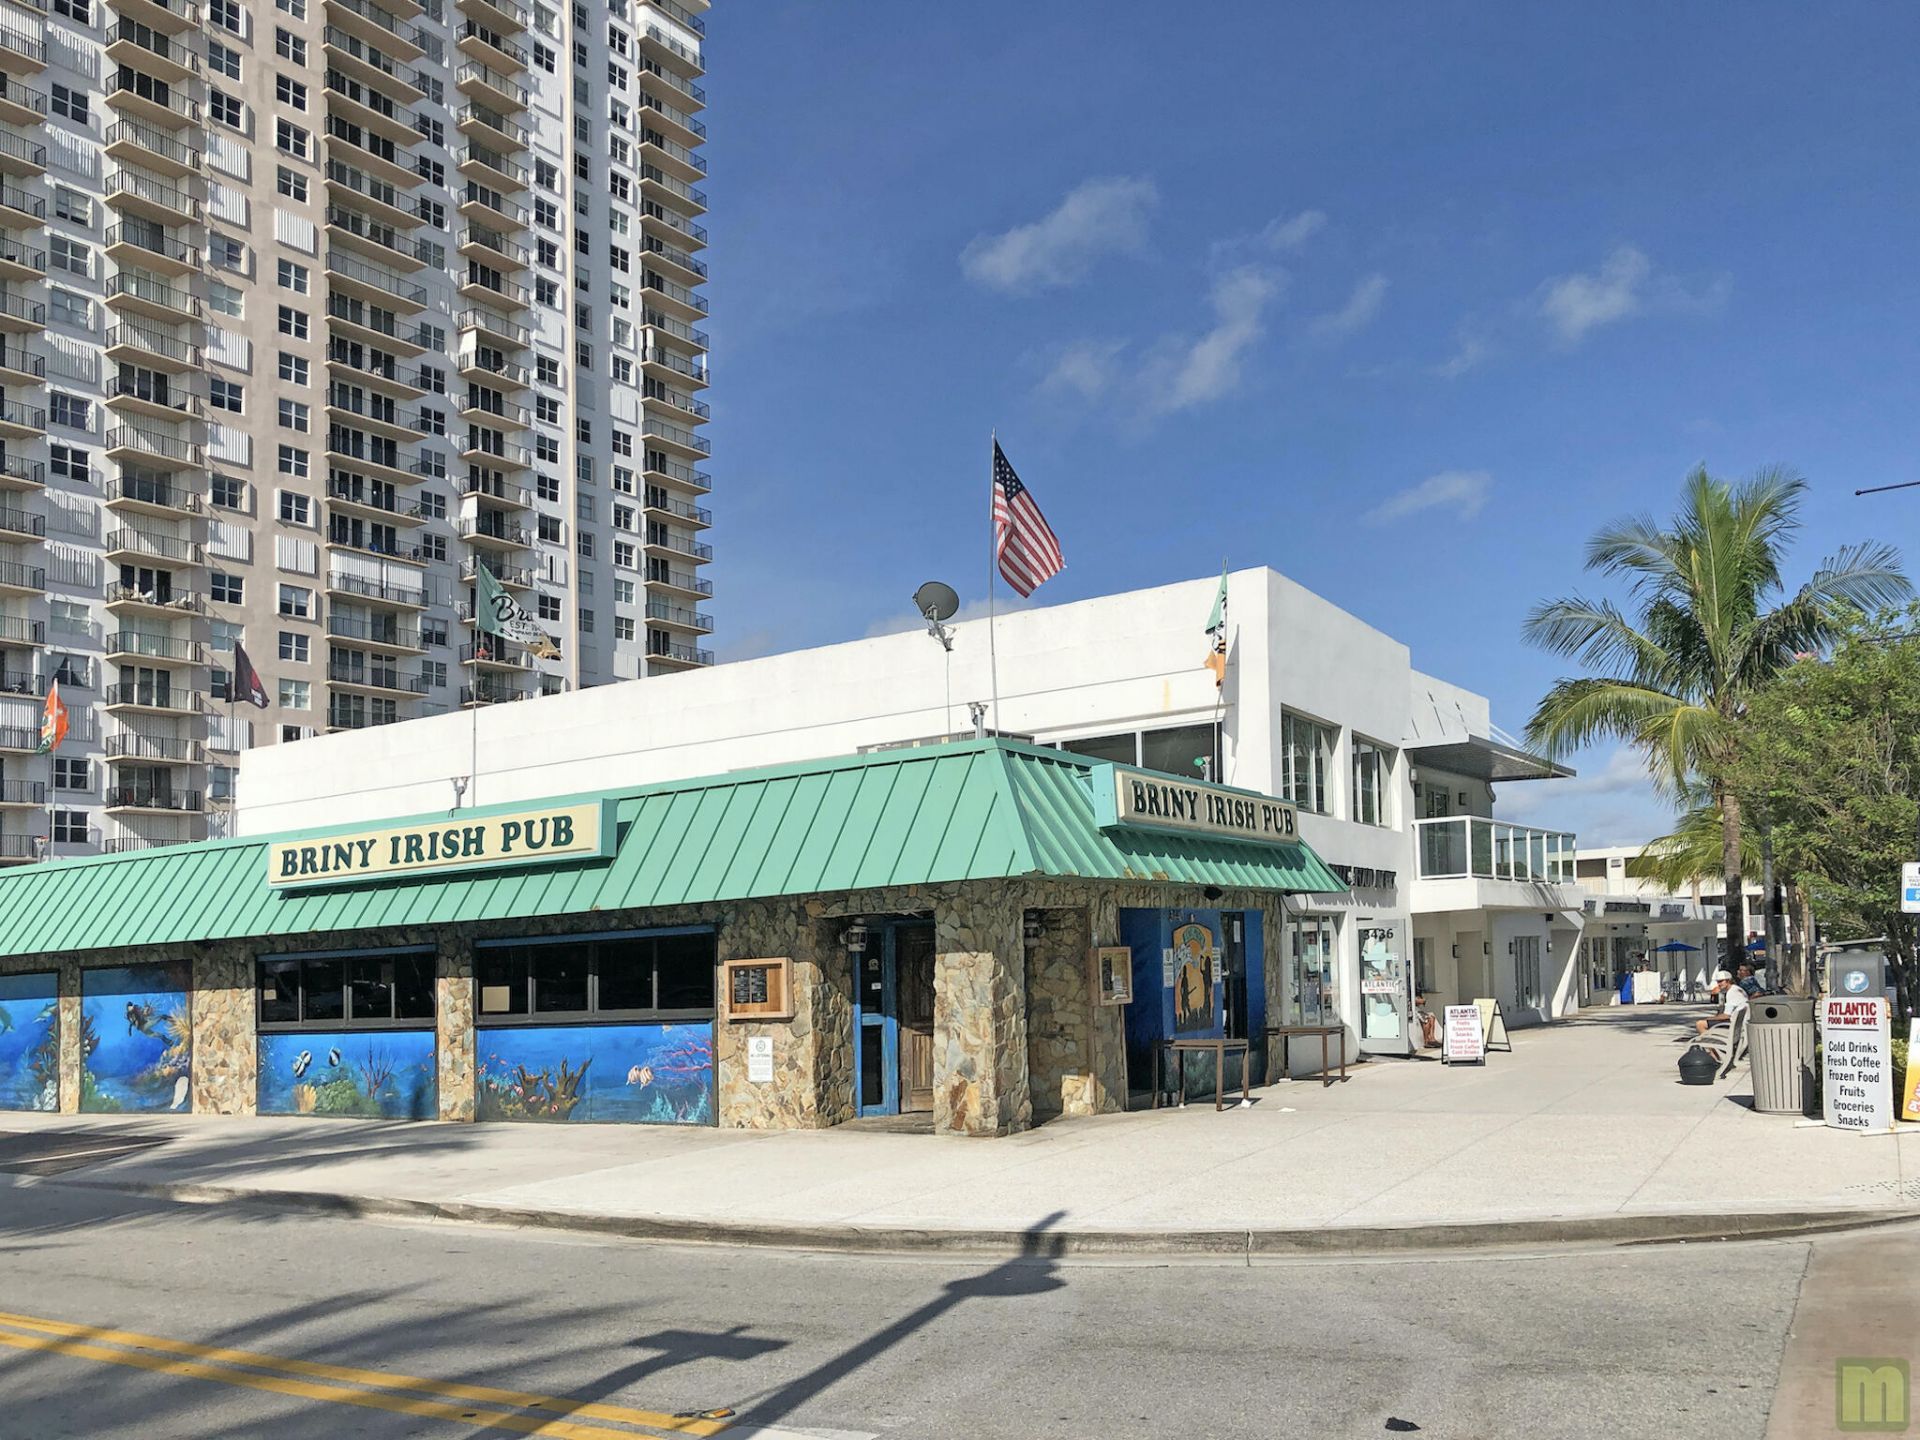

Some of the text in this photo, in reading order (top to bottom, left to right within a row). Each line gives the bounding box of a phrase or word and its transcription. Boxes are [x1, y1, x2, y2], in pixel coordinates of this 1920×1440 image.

[1132, 780, 1294, 834] BRINY IRISH PUB
[281, 815, 574, 877] BRINY IRISH PUB
[1363, 928, 1394, 941] 3436
[1828, 1002, 1877, 1016] ATLANTIC
[1828, 1017, 1877, 1026] FOOD MART CAFE
[1828, 1041, 1878, 1053] Cold Drinks
[1827, 1055, 1881, 1068] Fresh Coffee
[1829, 1069, 1880, 1083] Frozen Food
[1839, 1085, 1865, 1097] Fruits
[1833, 1099, 1875, 1113] Groceries
[1837, 1113, 1870, 1127] Snacks
